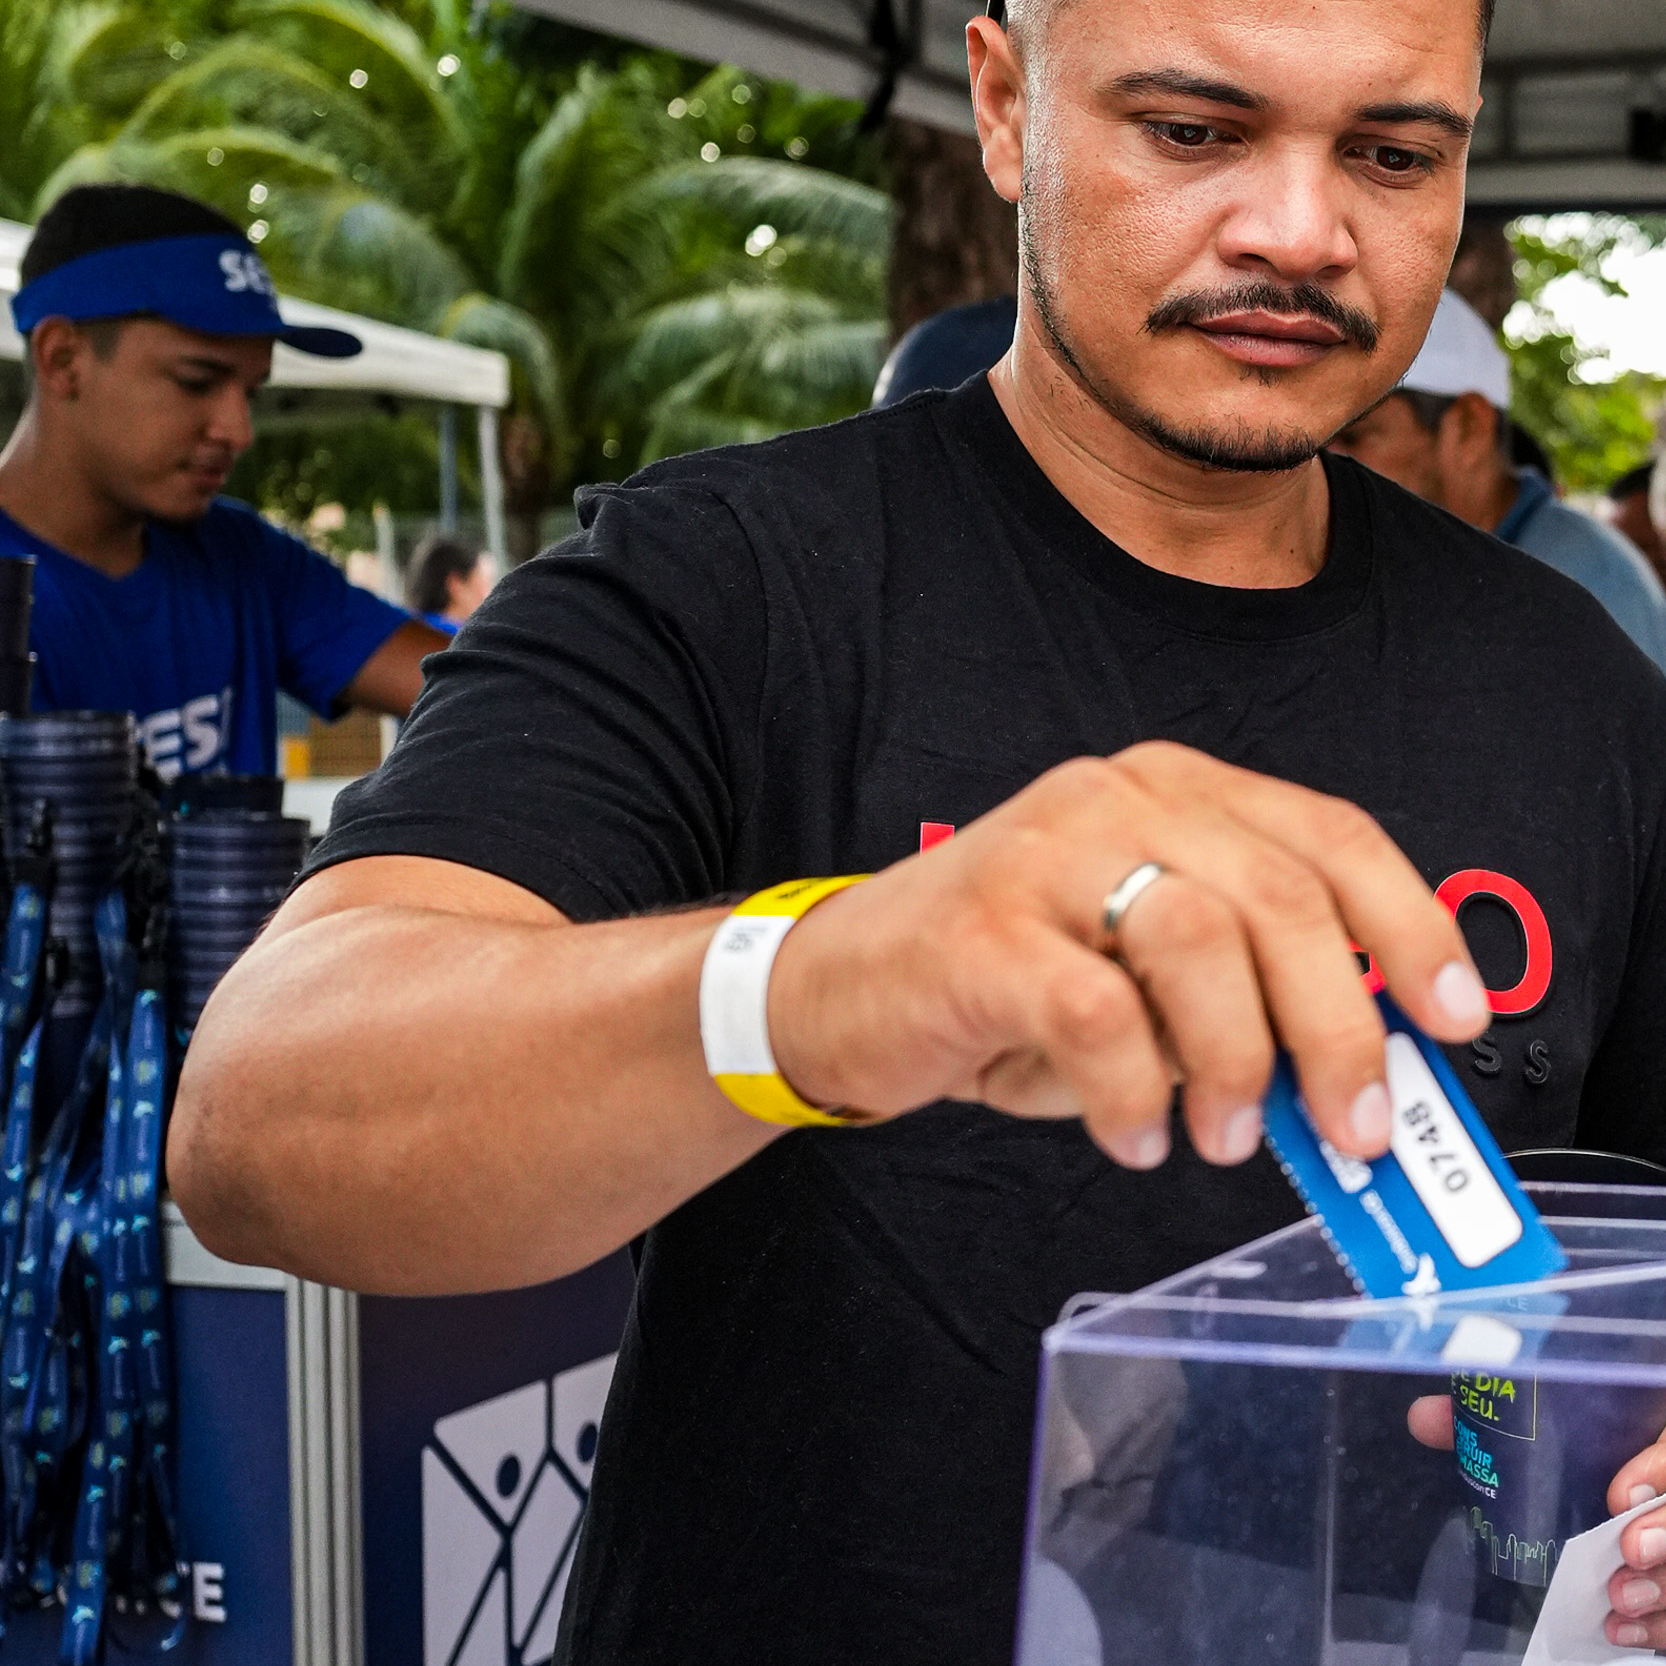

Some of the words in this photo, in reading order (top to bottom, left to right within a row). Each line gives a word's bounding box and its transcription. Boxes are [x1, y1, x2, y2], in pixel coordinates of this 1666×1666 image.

[1471, 1029, 1549, 1084] SS
[1402, 1099, 1469, 1194] 0748
[1475, 1372, 1517, 1404] DIA
